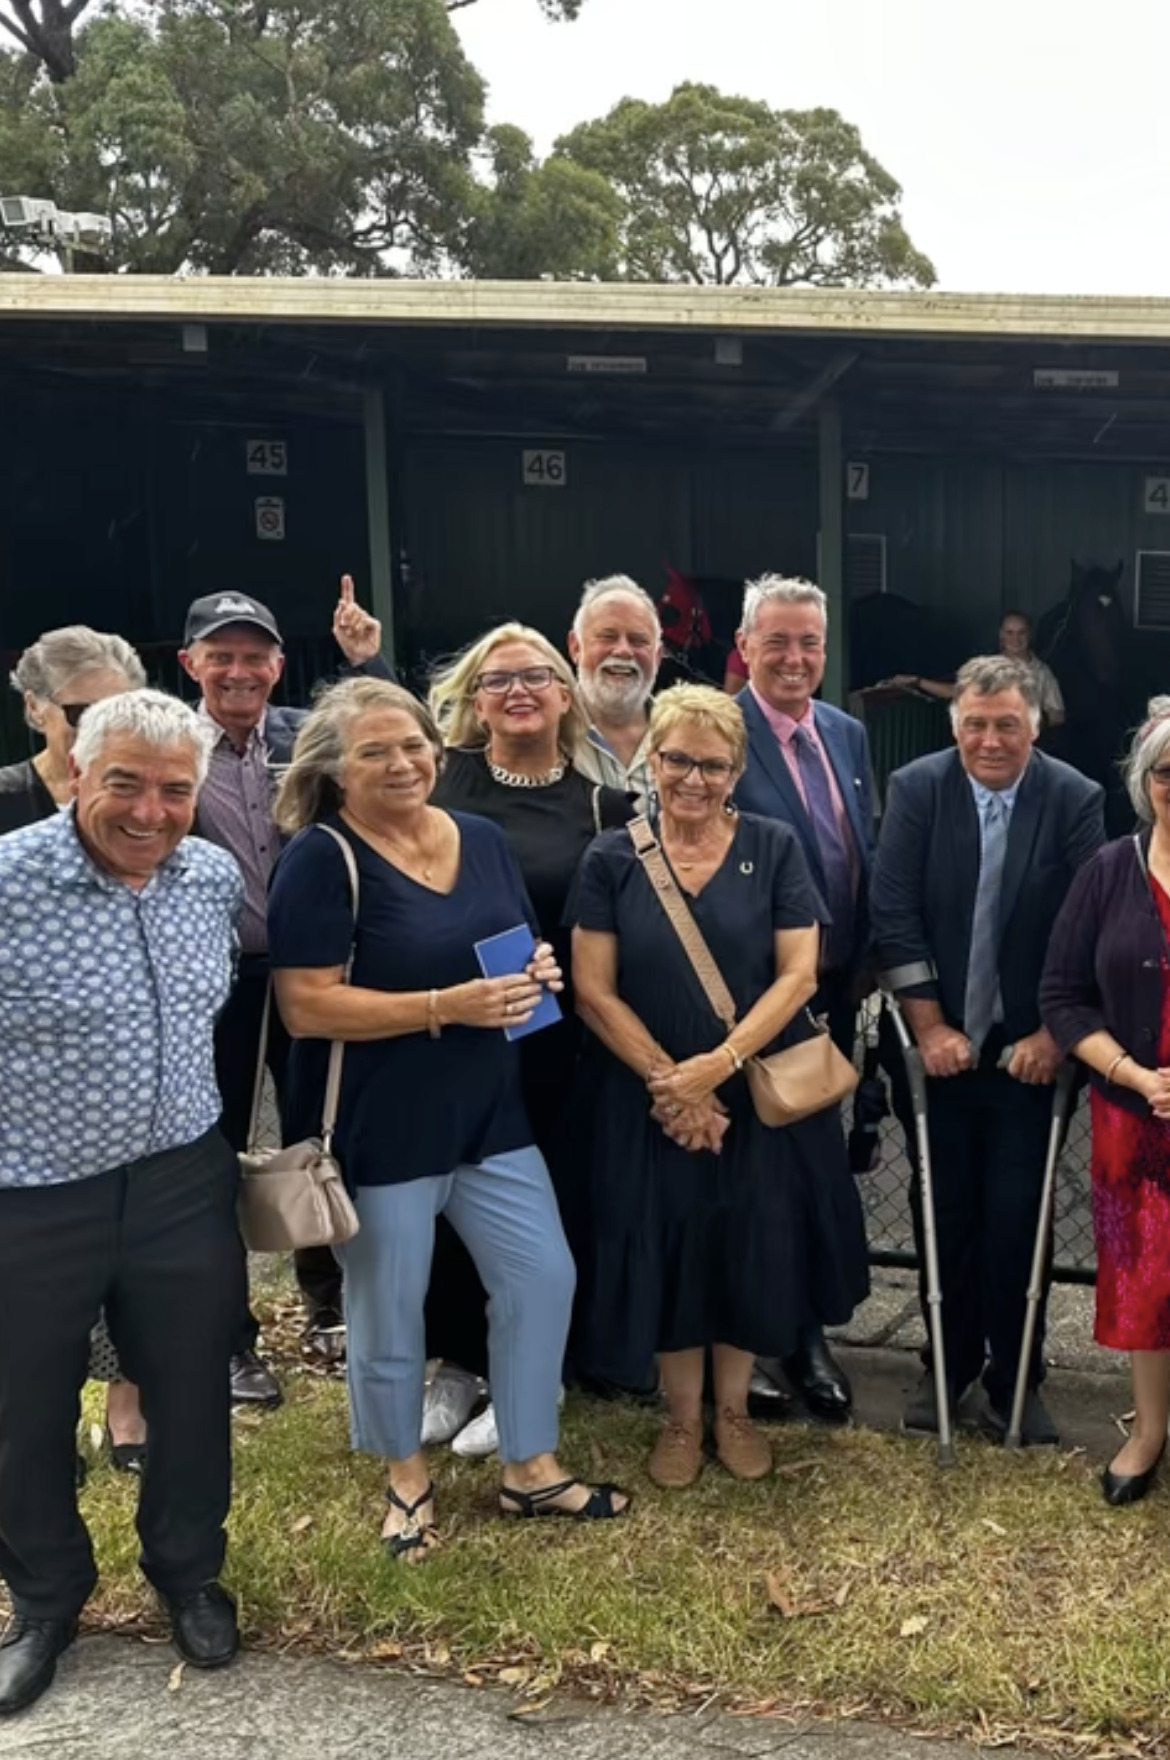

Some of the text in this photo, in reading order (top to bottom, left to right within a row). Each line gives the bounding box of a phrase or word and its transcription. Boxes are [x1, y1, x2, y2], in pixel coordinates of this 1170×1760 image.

[249, 443, 281, 470] 45
[528, 454, 561, 480] 46
[850, 465, 866, 493] 7
